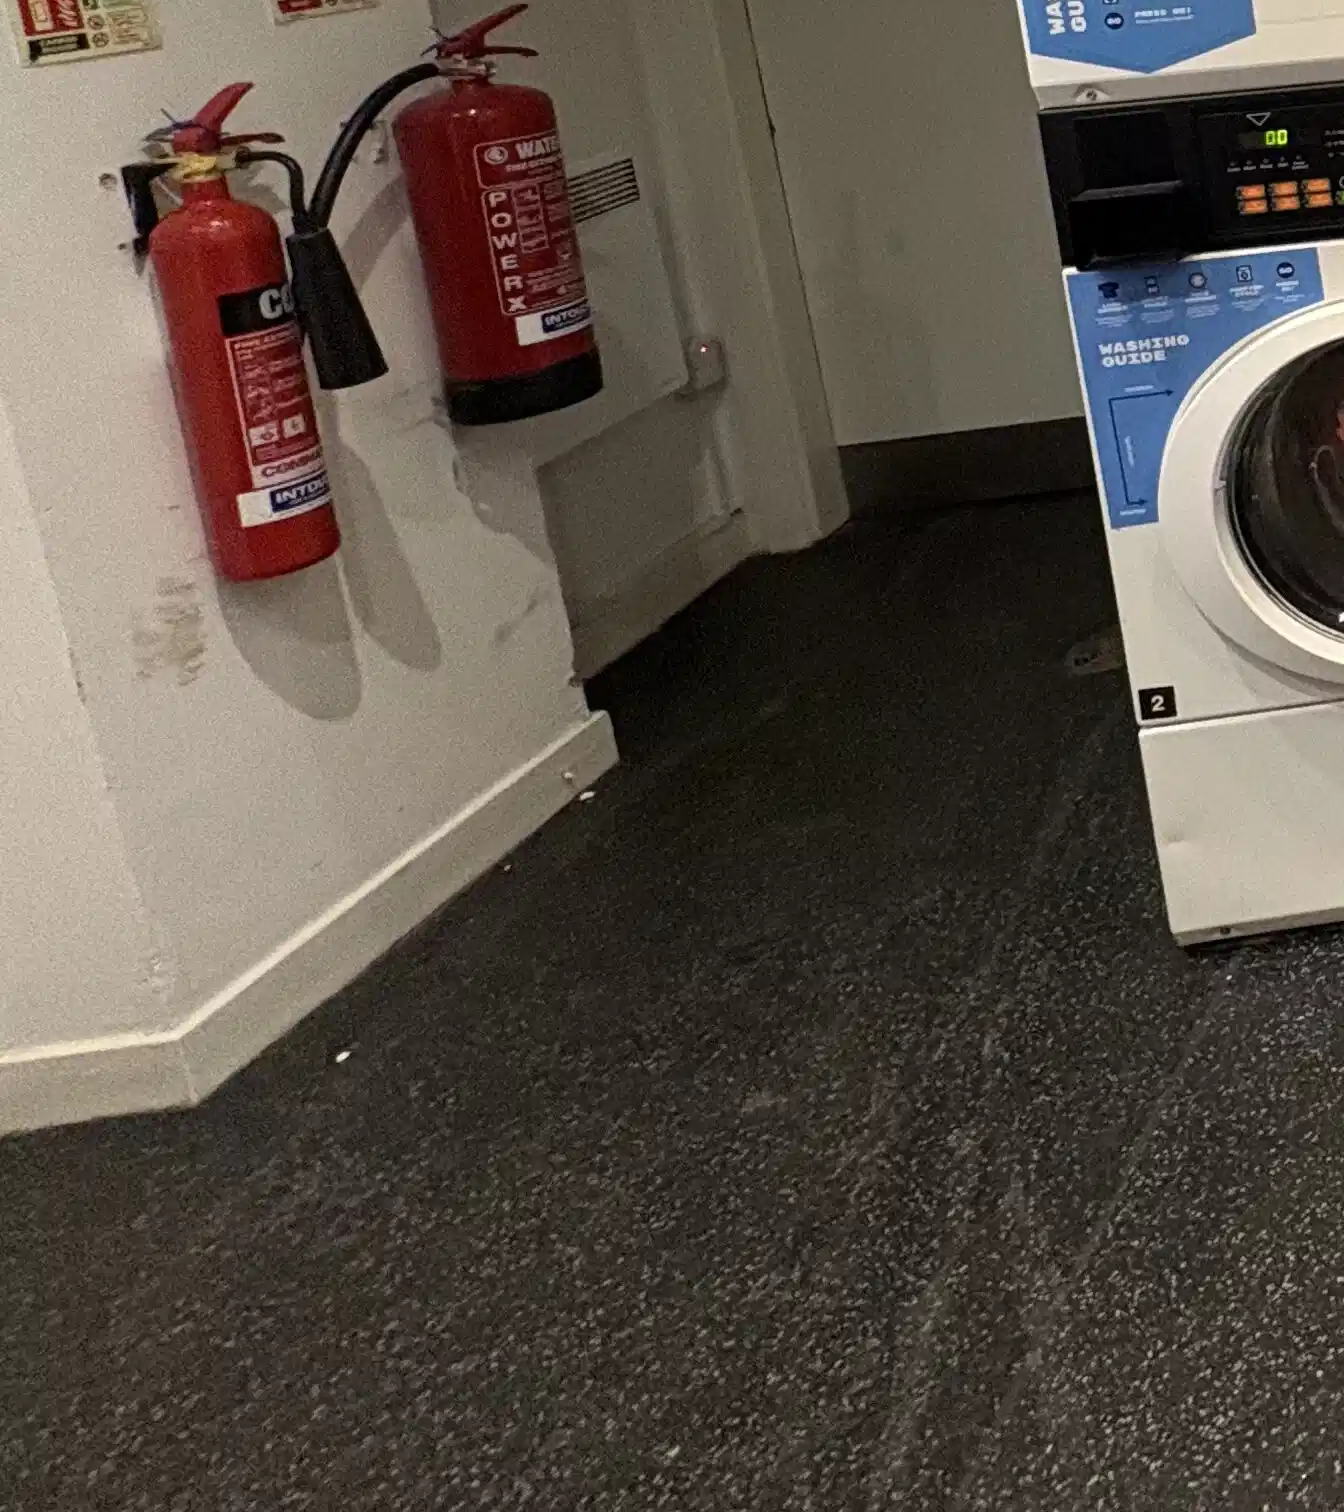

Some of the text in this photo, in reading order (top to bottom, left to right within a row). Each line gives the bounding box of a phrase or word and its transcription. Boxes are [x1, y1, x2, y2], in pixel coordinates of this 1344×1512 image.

[1098, 334, 1190, 356] WASHING
[1101, 351, 1167, 368] GUIDE
[1151, 695, 1165, 712] 2
